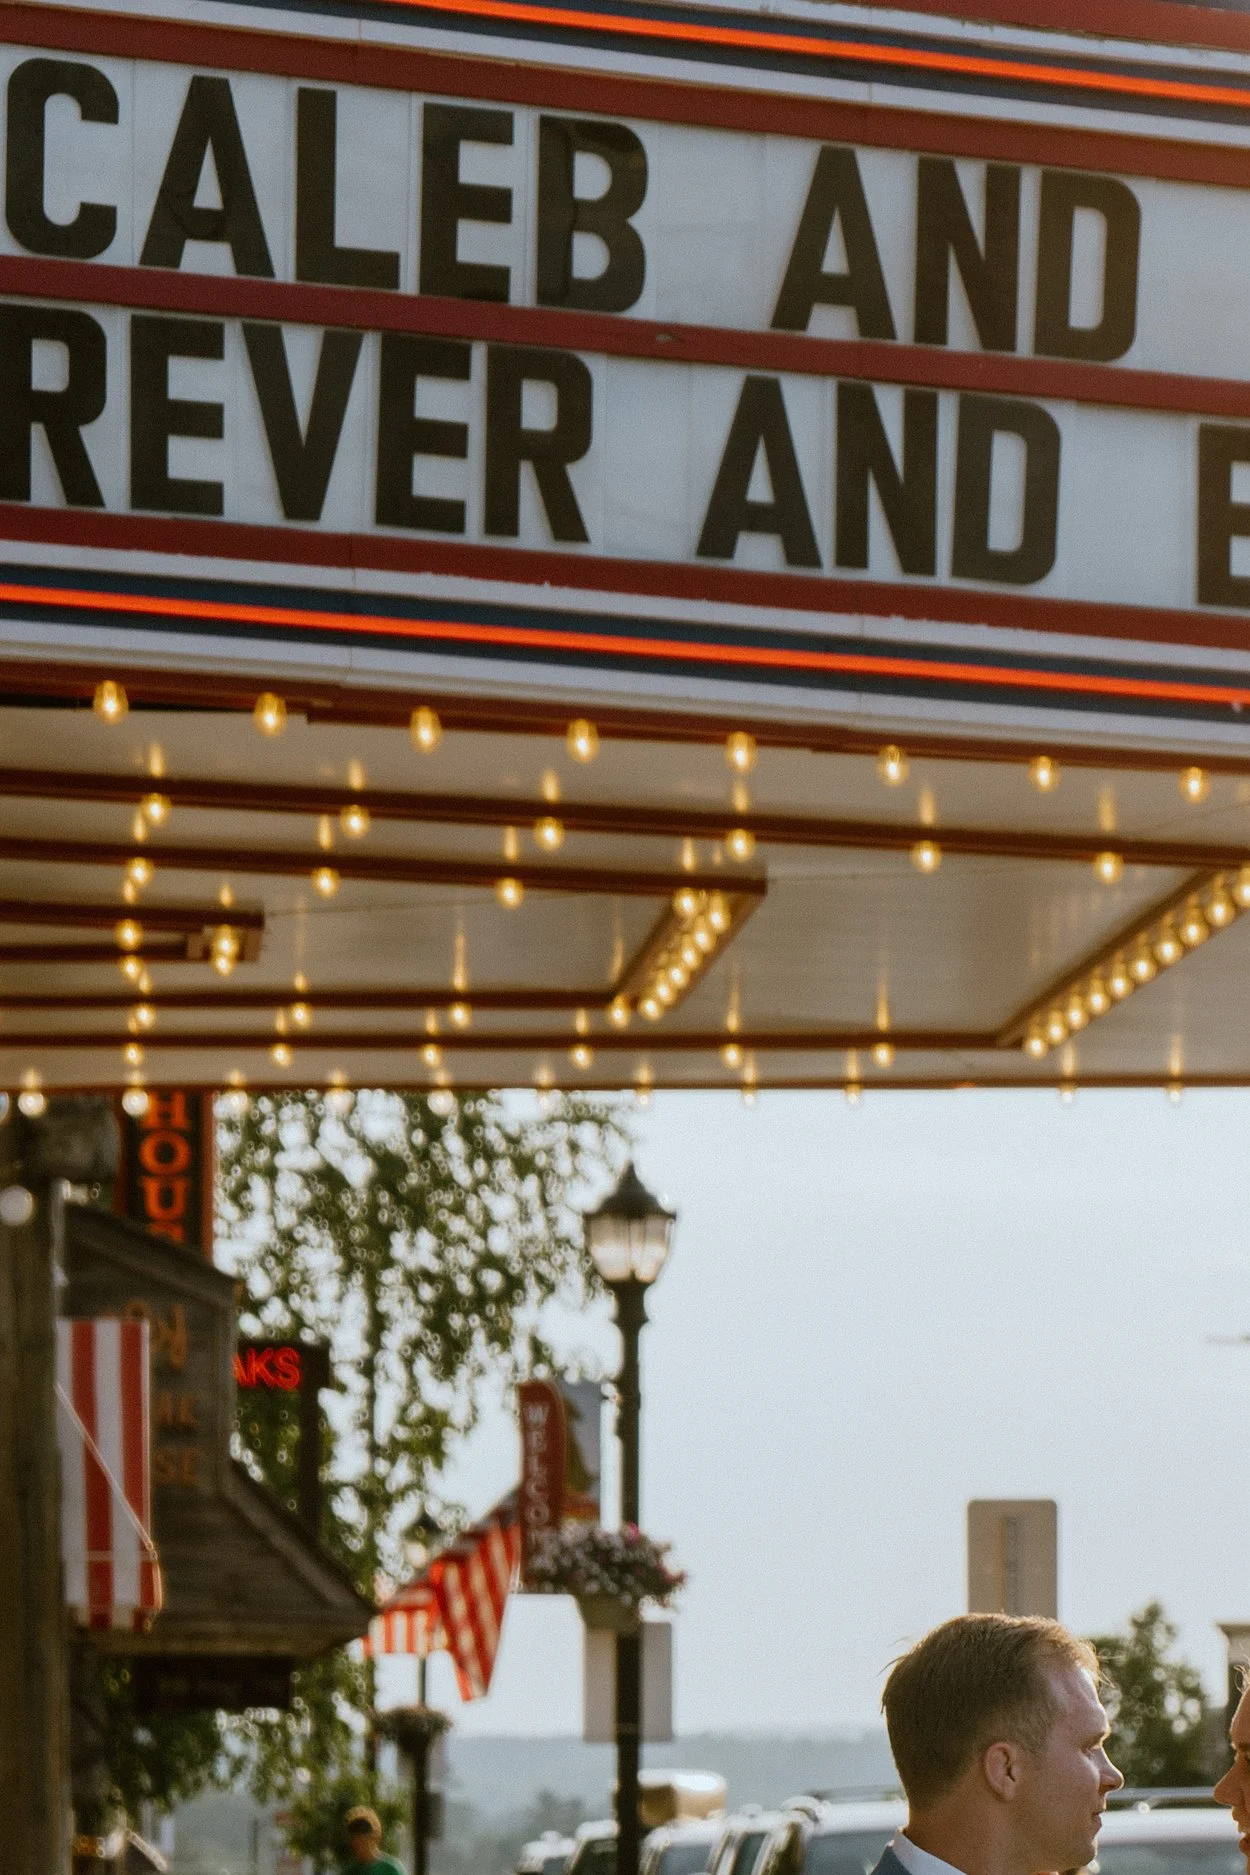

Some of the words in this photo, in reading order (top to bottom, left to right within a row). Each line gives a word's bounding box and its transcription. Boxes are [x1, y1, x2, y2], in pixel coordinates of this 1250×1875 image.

[4, 56, 650, 315] CALEB
[769, 145, 1142, 364] AND
[0, 303, 594, 544] REVER
[695, 373, 1062, 586] AND
